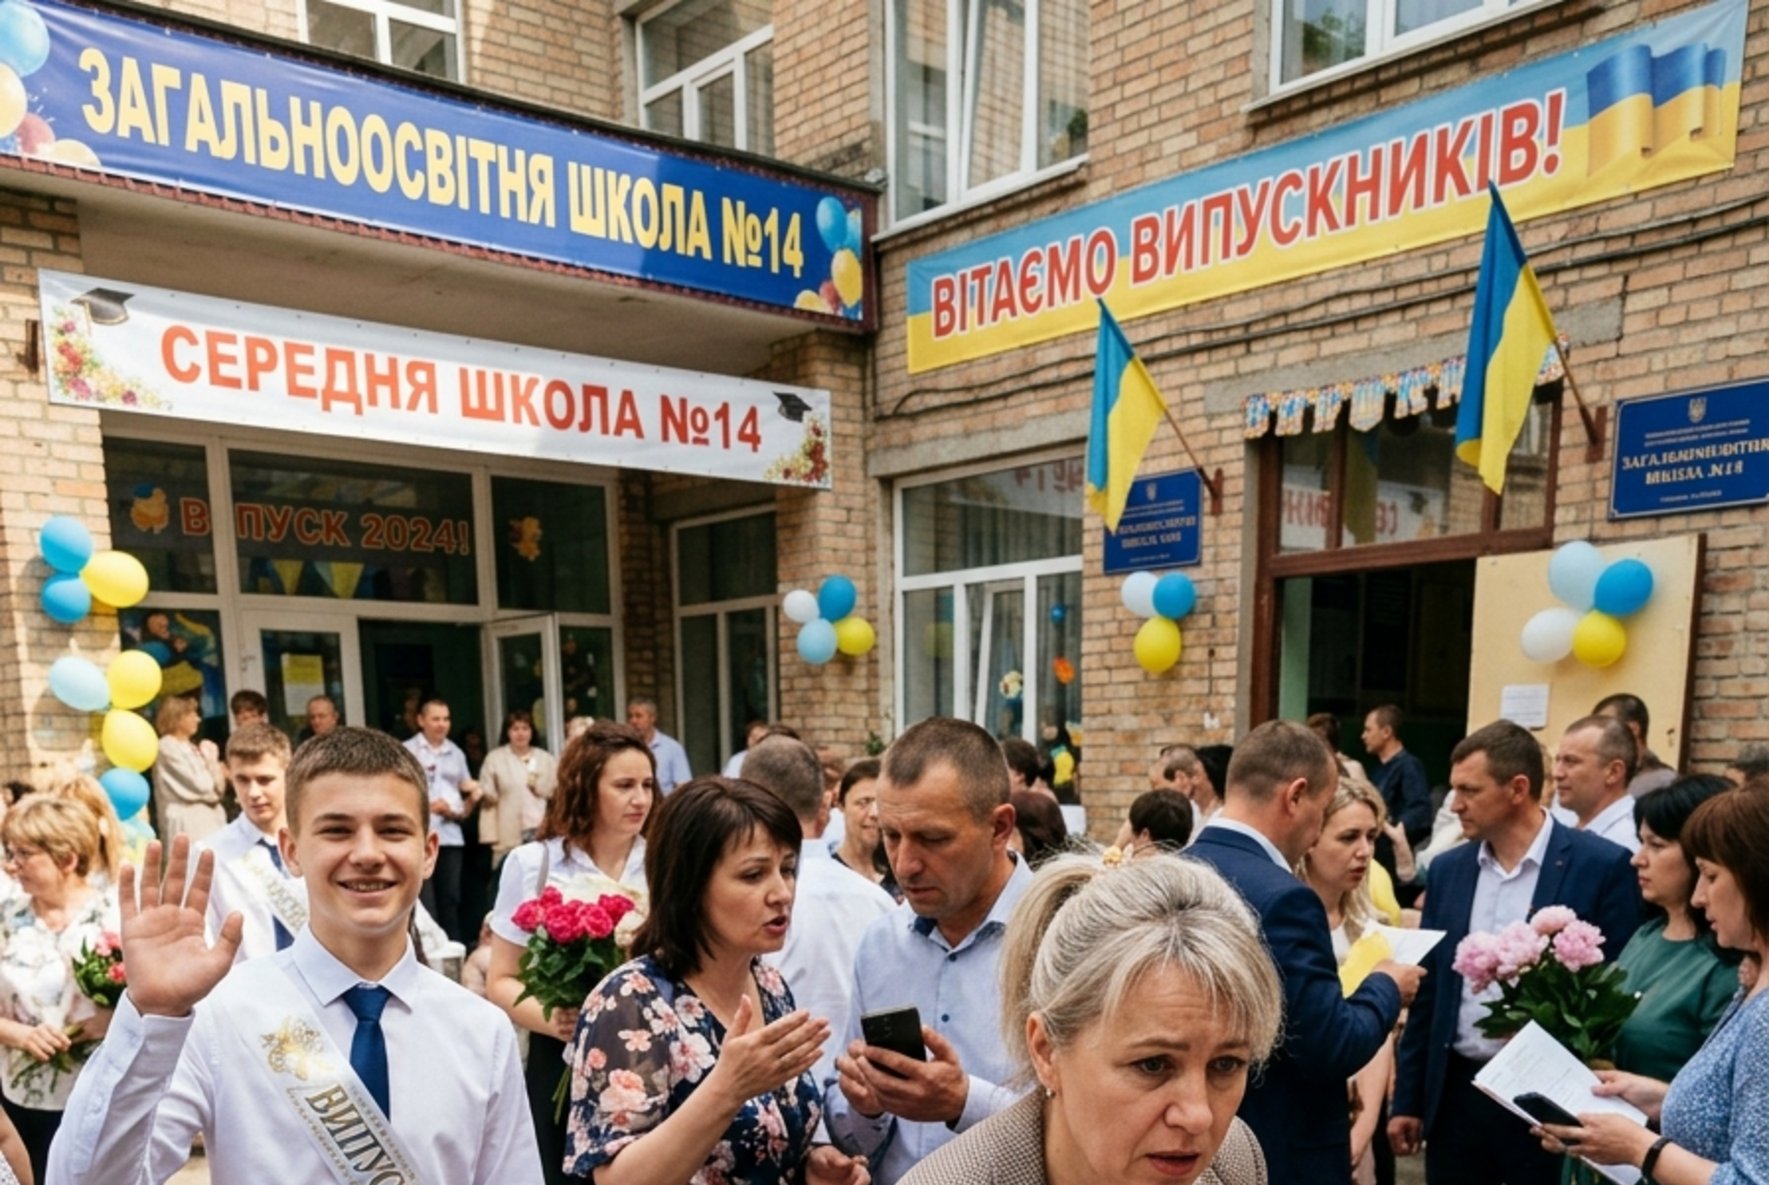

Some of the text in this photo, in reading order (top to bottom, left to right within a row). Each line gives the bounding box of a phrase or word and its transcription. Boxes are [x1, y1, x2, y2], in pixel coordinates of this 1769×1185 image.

[79, 48, 804, 278] ЗАГАЛЬНООСВІТНЯ ШКОЛА №14
[932, 89, 1566, 339] ВІТАЄМО ВИПУСКНИКІВ!
[161, 325, 762, 454] СЕРЕДНЯ ШКОЛА №14
[361, 514, 470, 555] 2024!
